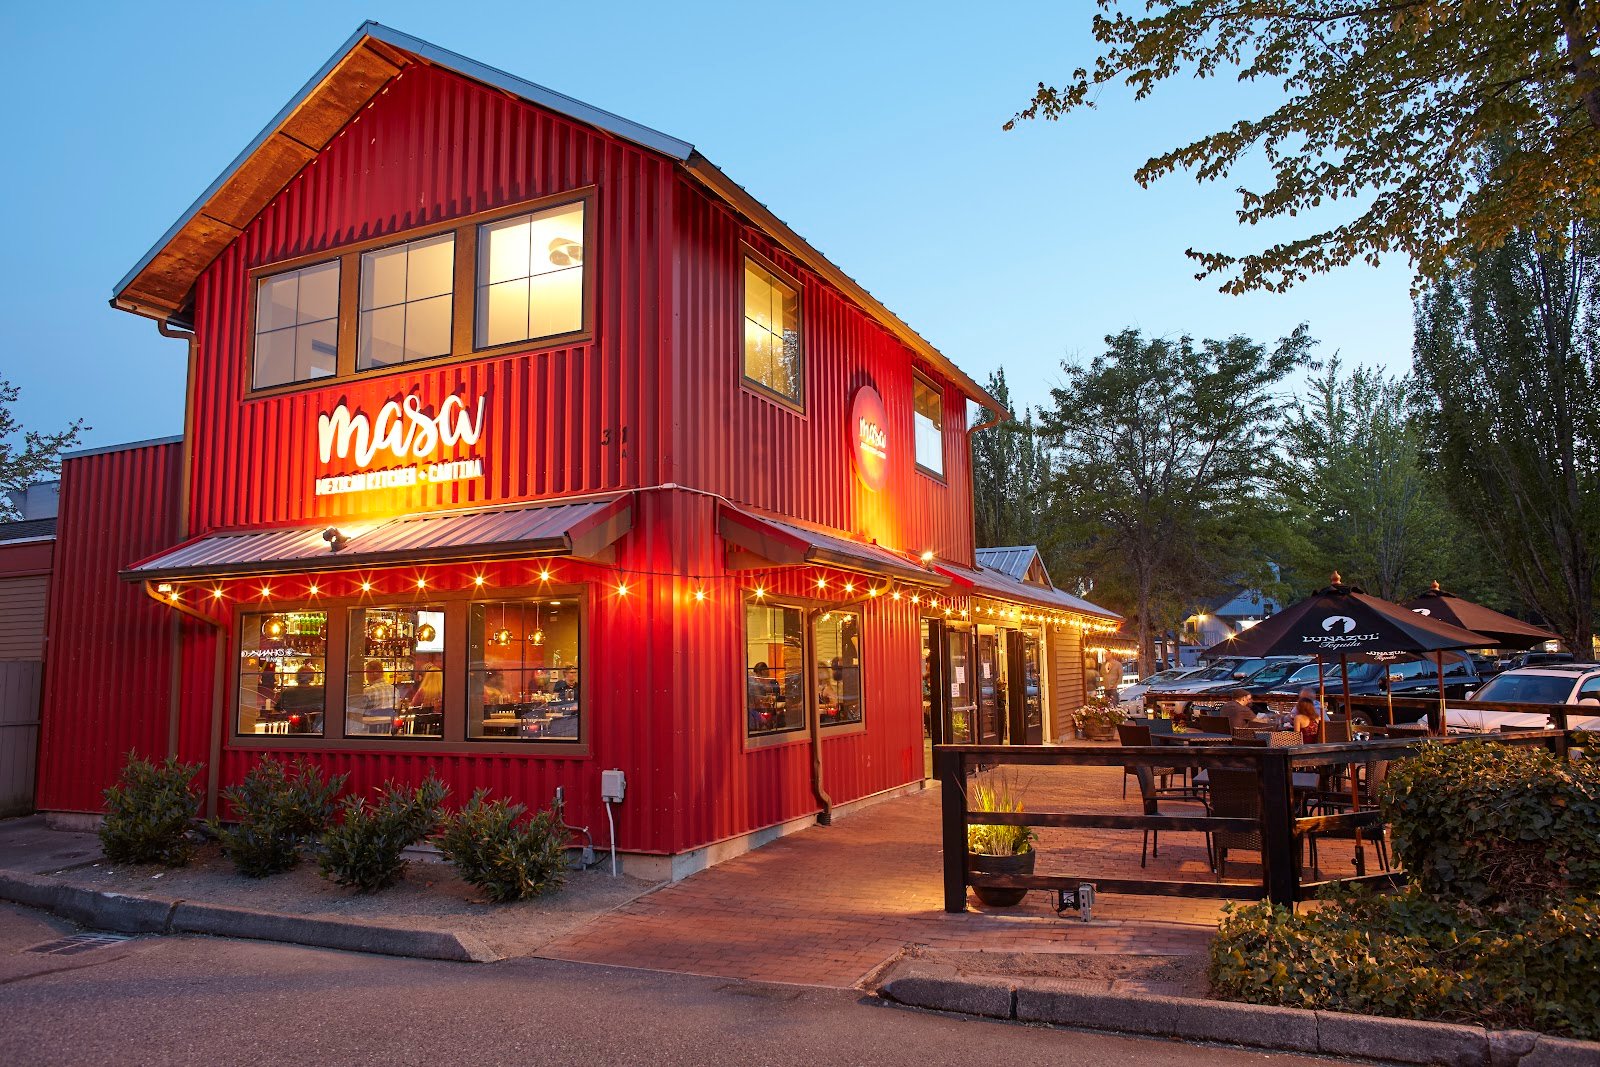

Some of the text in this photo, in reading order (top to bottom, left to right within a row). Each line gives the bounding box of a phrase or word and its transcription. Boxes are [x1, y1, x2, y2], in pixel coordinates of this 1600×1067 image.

[318, 394, 487, 467] masa
[859, 417, 886, 449] masa
[315, 474, 365, 496] MEXICAN
[366, 468, 416, 490] KITCHEN
[428, 459, 484, 482] CANTINA
[1302, 633, 1379, 643] LUNAZUL
[1318, 640, 1363, 651] Tequila
